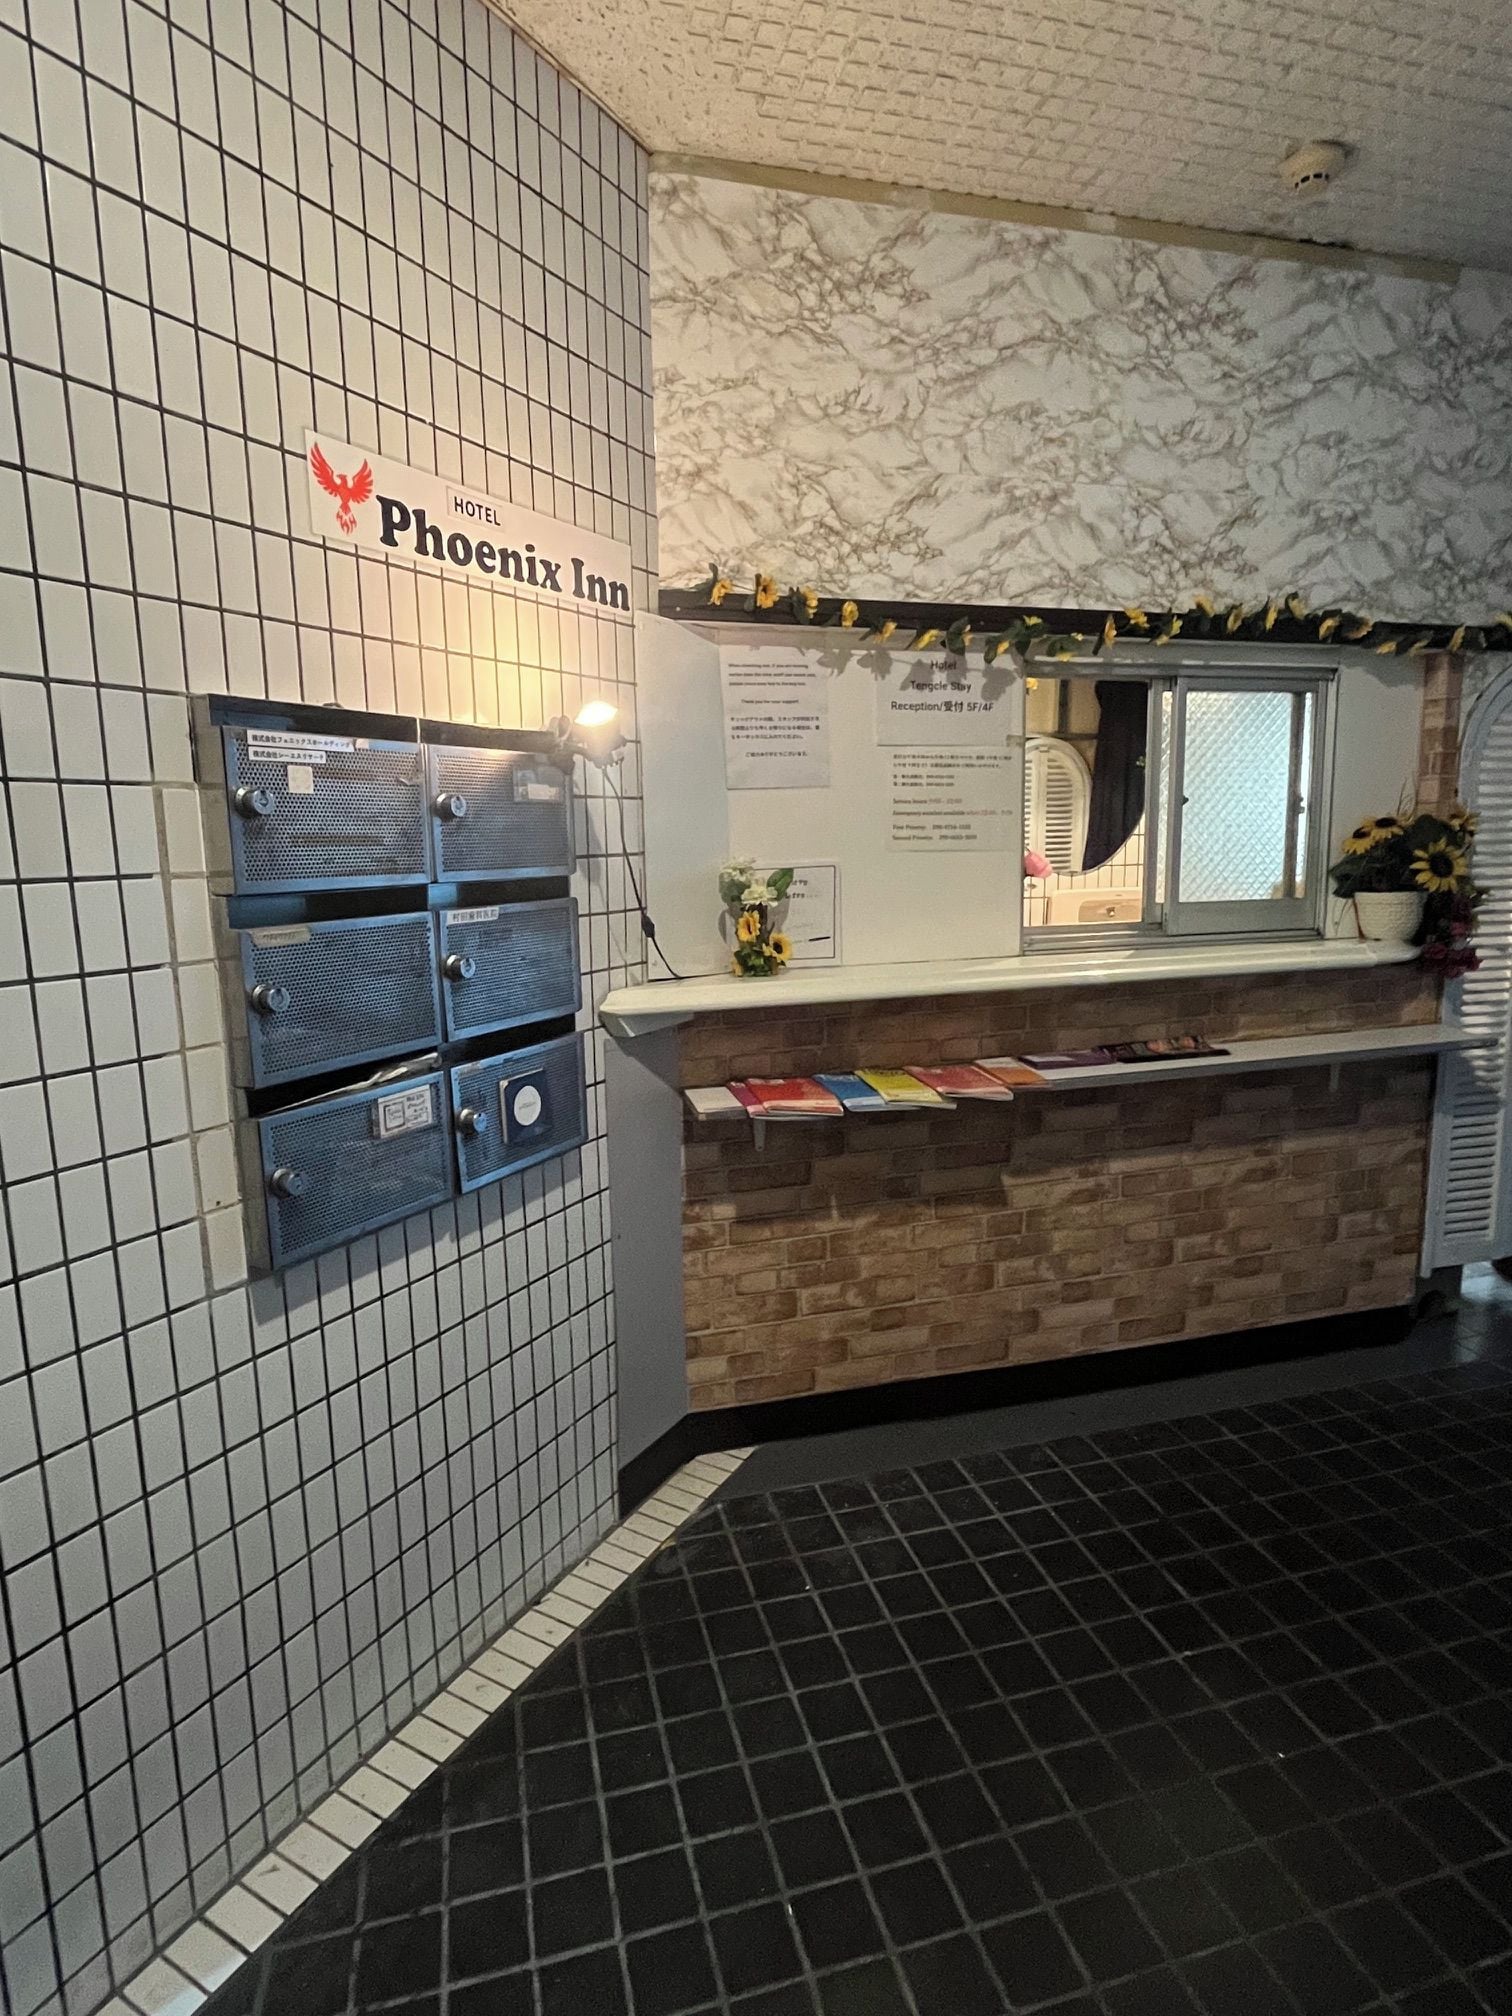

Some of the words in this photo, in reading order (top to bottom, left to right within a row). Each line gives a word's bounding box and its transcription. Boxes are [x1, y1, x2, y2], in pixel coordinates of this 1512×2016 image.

[454, 495, 501, 527] HOTEL
[375, 494, 563, 593] Phoenix
[570, 557, 631, 612] Inn
[930, 660, 958, 671] Hotel
[950, 681, 972, 694] Stay
[966, 702, 995, 713] 5F/4F
